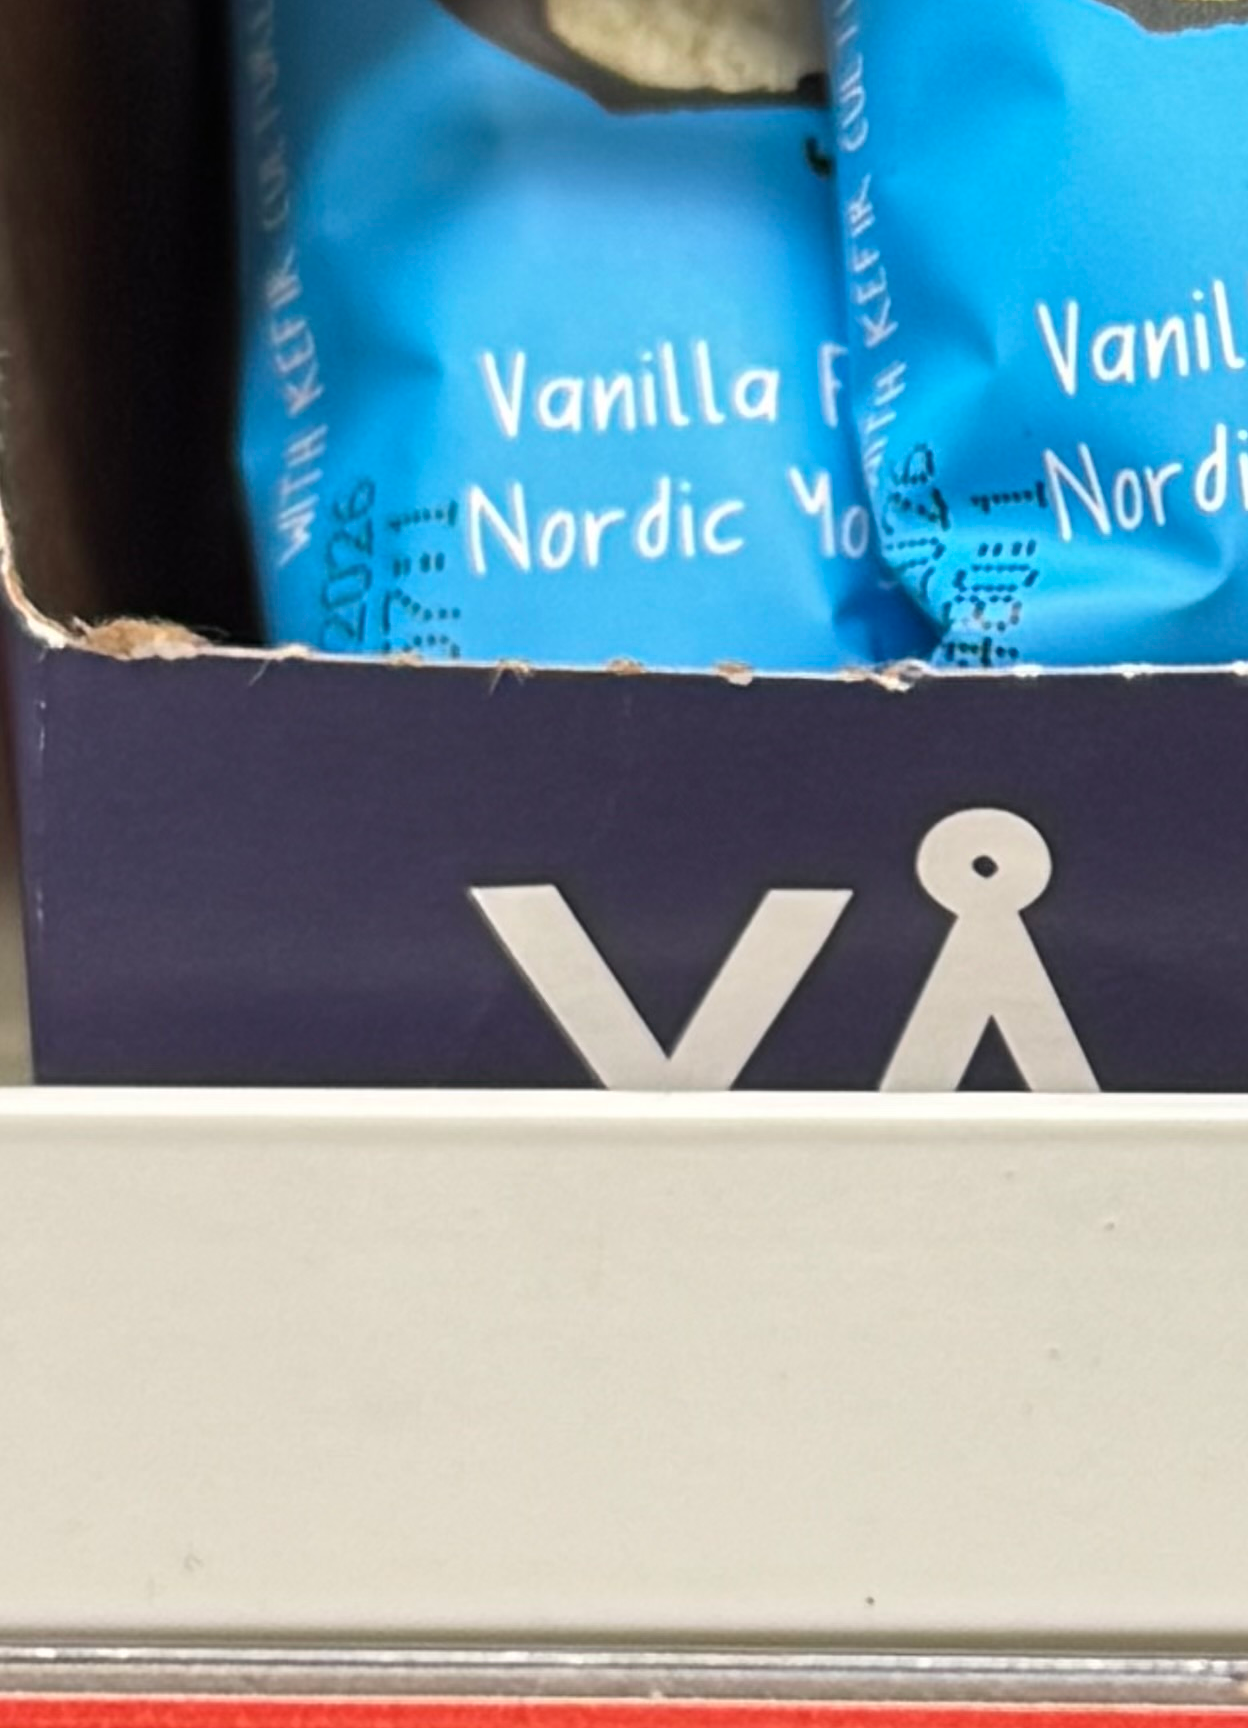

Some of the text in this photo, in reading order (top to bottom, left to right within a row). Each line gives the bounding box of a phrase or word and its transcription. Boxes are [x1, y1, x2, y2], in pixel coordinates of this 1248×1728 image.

[261, 245, 324, 416] KEFIR
[848, 173, 900, 348] KEFIR
[480, 341, 780, 437] Vanilla
[275, 425, 328, 566] WITH
[320, 479, 376, 651] 2026
[468, 476, 747, 574] Nordic
